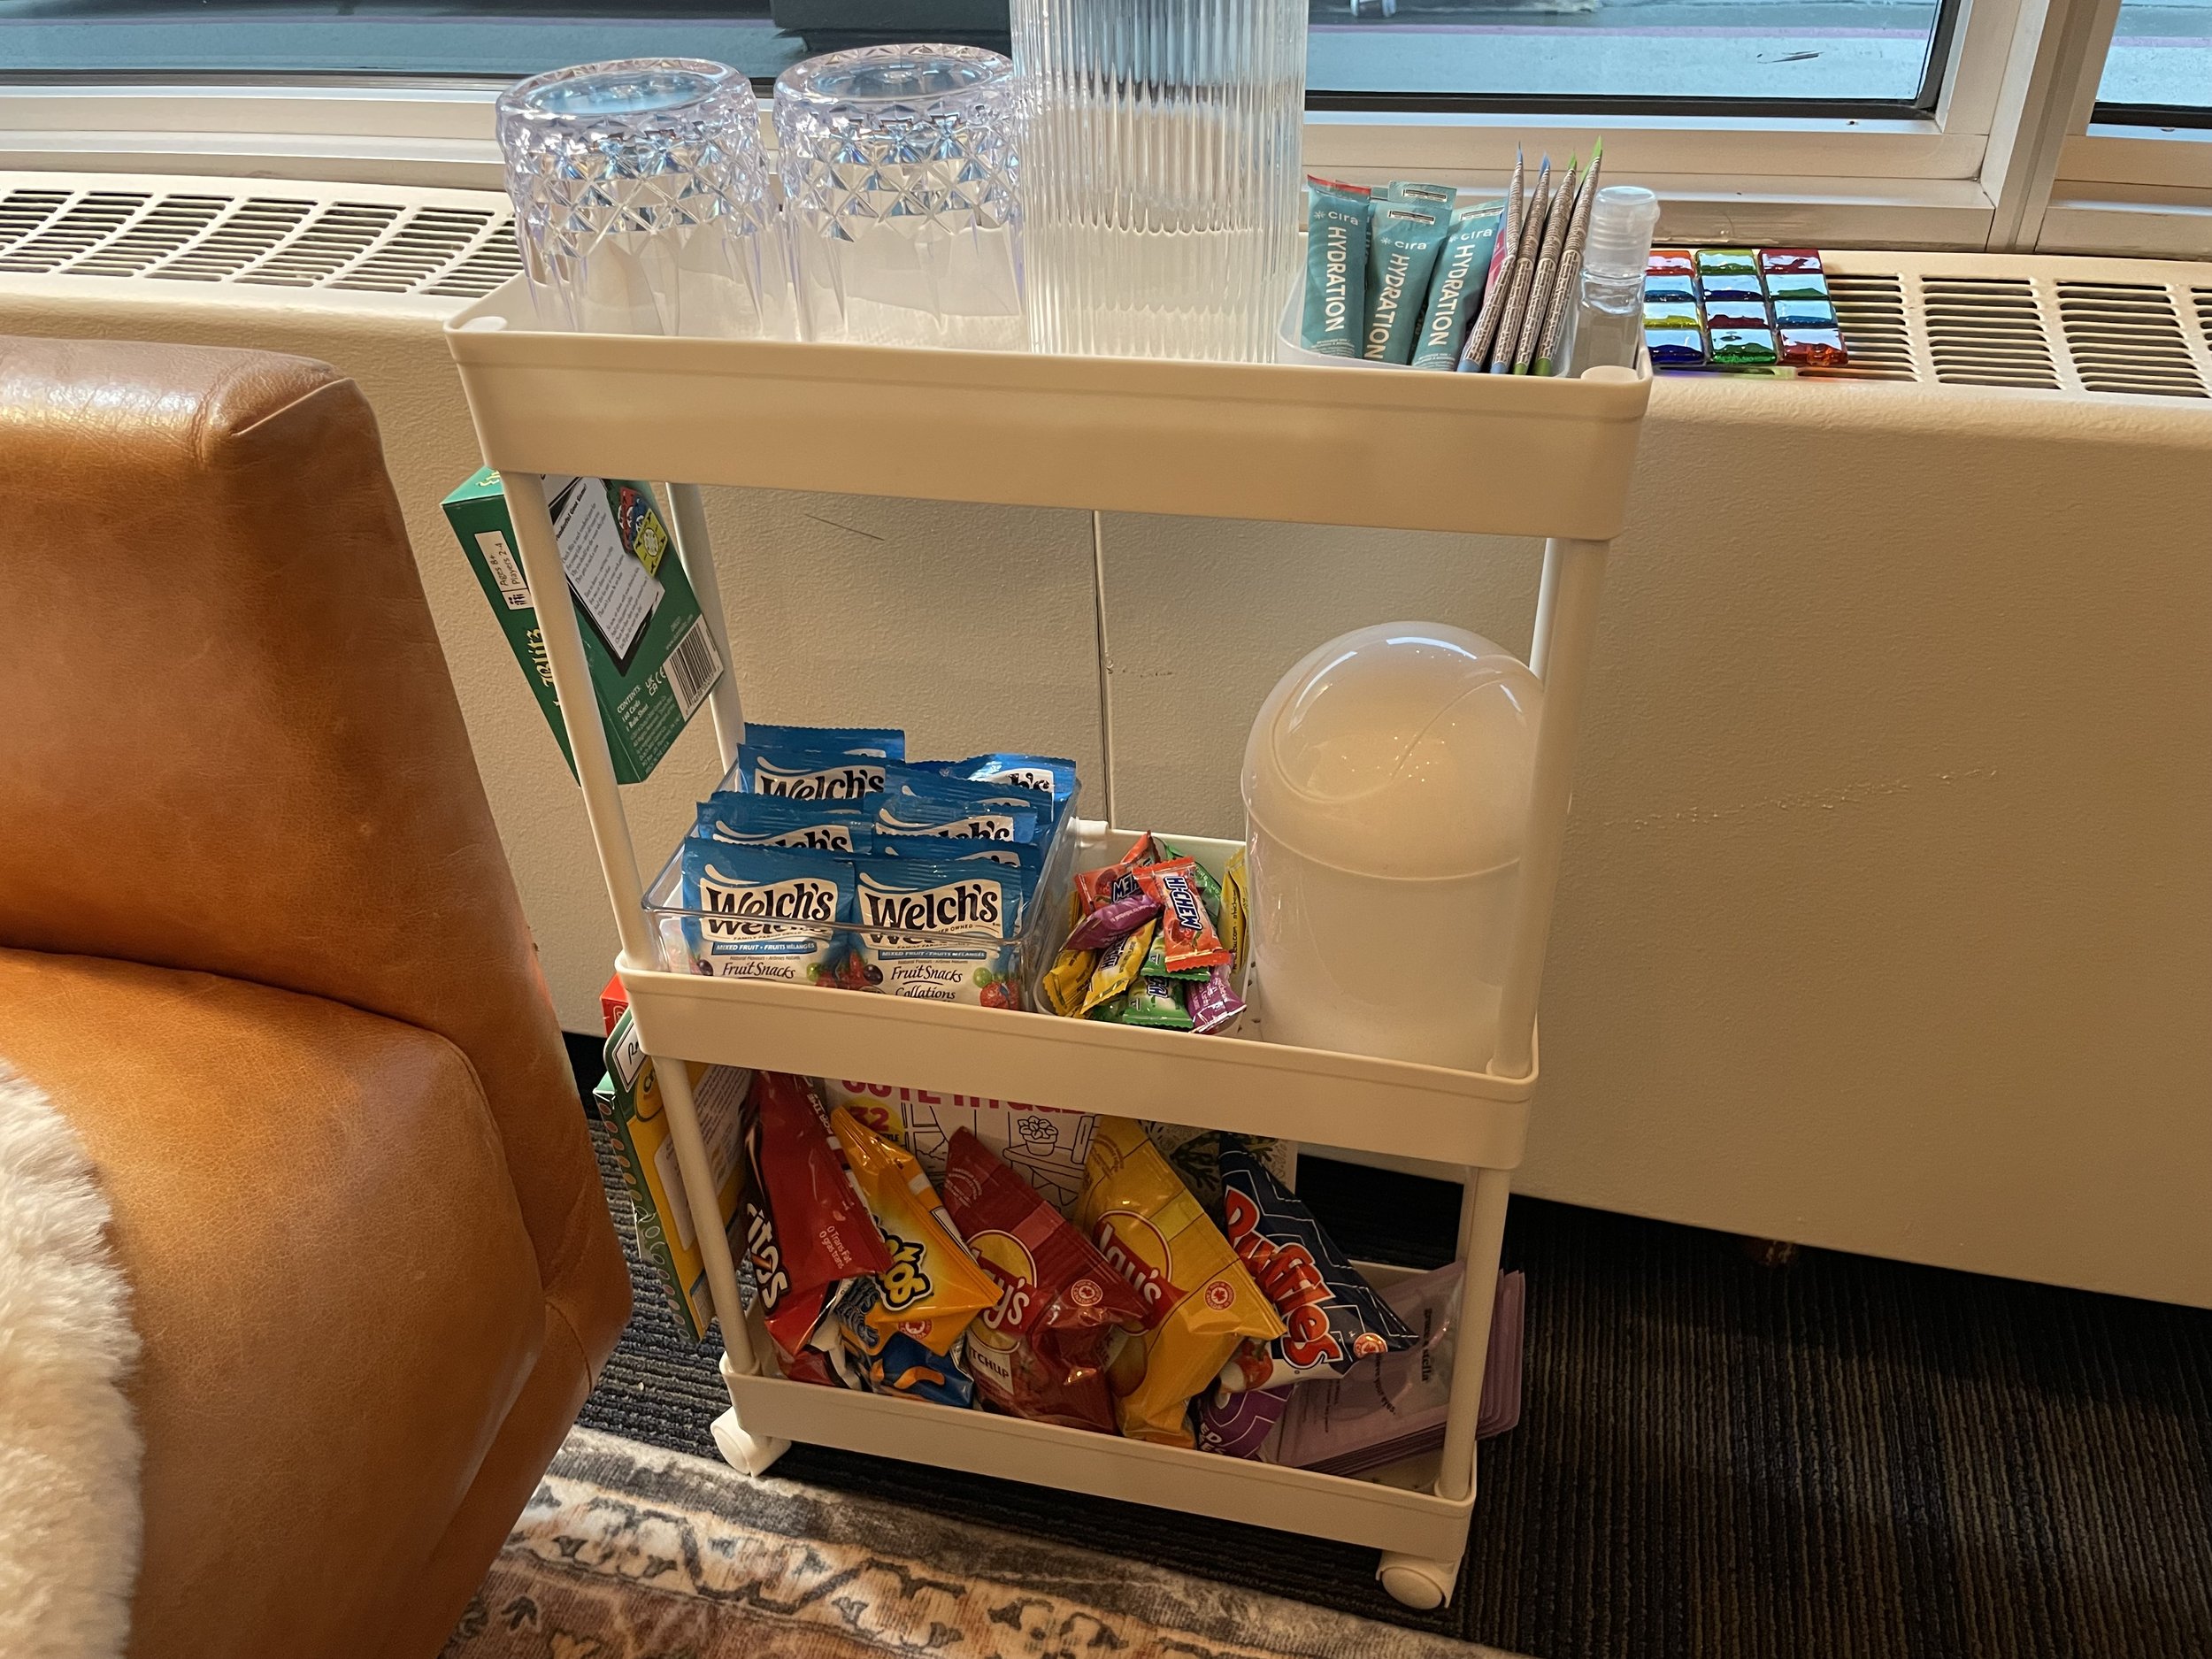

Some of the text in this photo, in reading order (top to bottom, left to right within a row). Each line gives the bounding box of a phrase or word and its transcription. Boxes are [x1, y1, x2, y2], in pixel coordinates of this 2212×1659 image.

[1328, 211, 1359, 226] cira
[1394, 241, 1427, 250] cira
[1460, 229, 1493, 242] cira
[1325, 227, 1347, 332] HYDRATION
[1428, 244, 1475, 346] HYDRATION
[1364, 253, 1410, 359] HYDRATION
[490, 555, 506, 586] Ages 8+
[495, 542, 520, 585] Players 2-4
[645, 675, 655, 687] UK
[649, 685, 658, 696] CA
[706, 883, 833, 933] Welch's
[864, 884, 998, 936] Welch's
[1163, 875, 1203, 931] HI-CHEW
[722, 961, 796, 979] Fruit Snacks
[891, 965, 964, 983] Fruit Snacks
[895, 985, 956, 1000] Collations
[747, 1203, 788, 1309] itos
[821, 1236, 834, 1254] gras
[831, 1250, 845, 1270] trans
[832, 1230, 845, 1252] Trans
[841, 1248, 852, 1263] Fat
[1225, 1186, 1343, 1369] Ruffles
[972, 1348, 1010, 1379] TCHUP
[1373, 1378, 1385, 1395] your
